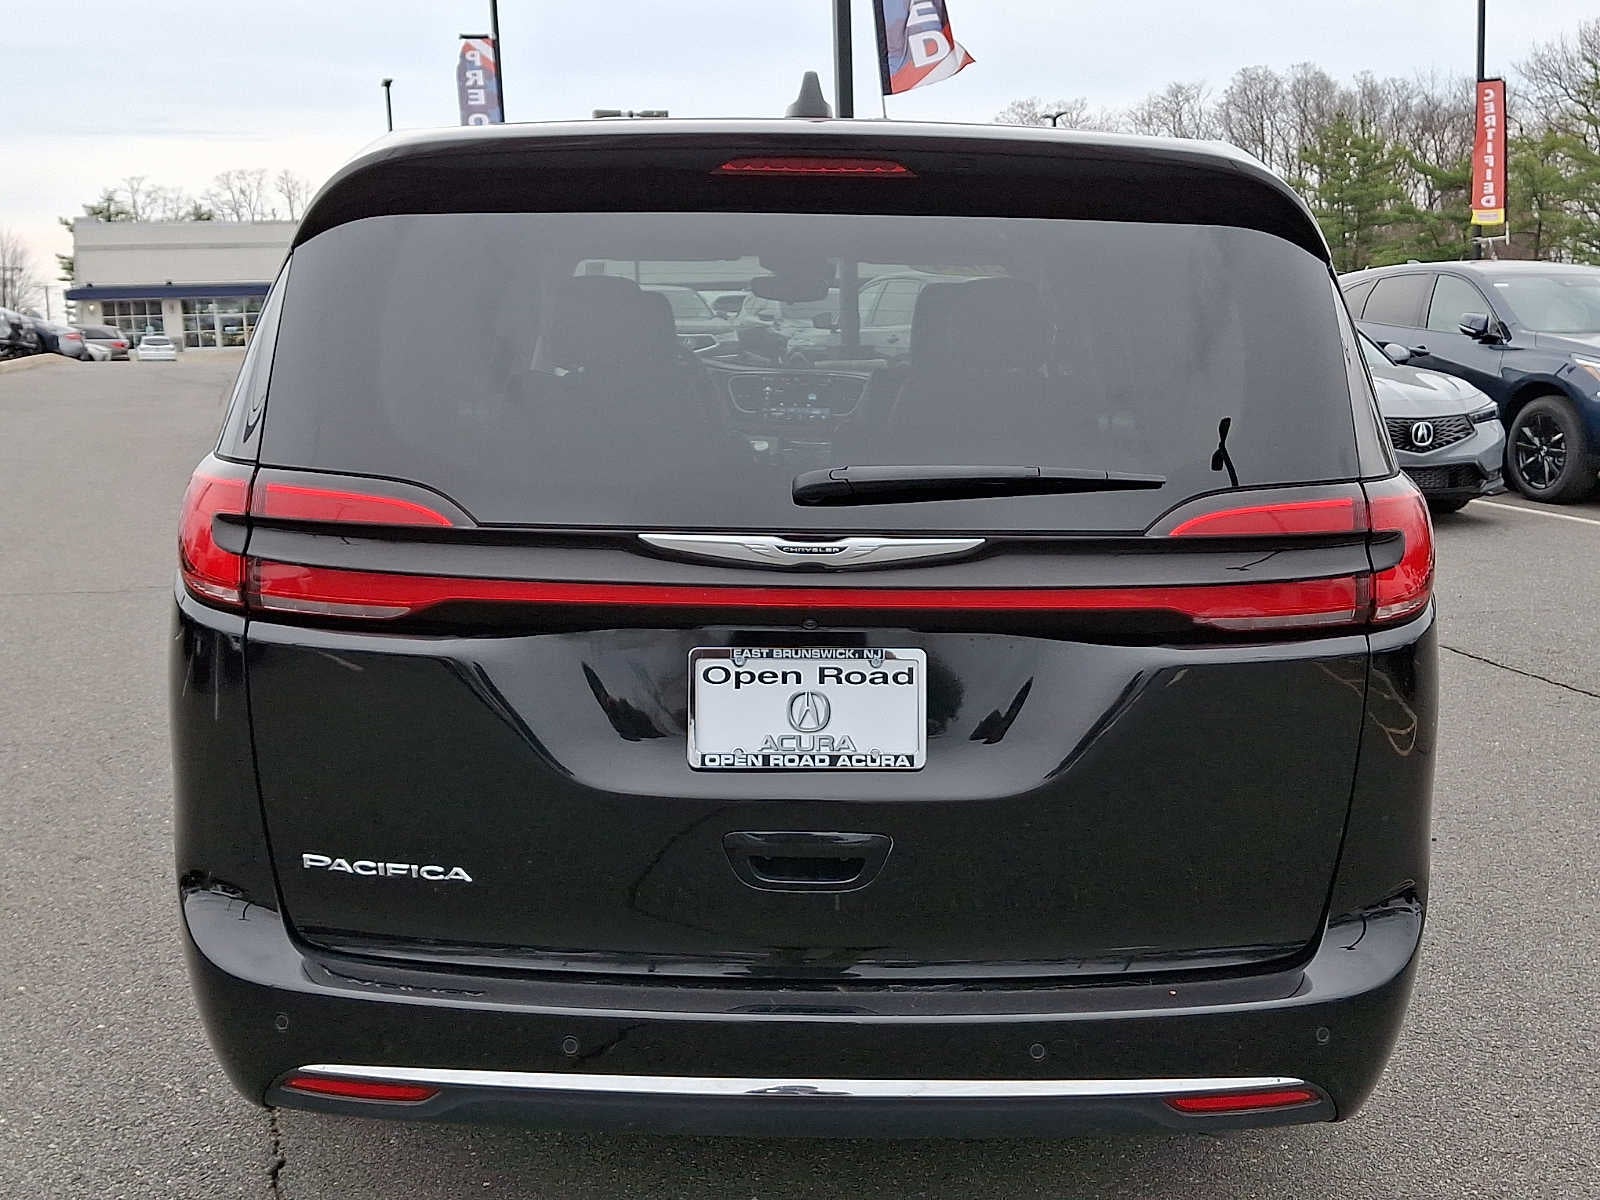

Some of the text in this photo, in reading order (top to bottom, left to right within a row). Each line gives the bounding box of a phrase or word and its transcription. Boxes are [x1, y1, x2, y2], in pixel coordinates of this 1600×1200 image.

[733, 649, 769, 658] EAST
[863, 649, 882, 659] NJ
[702, 665, 915, 690] Open Road
[758, 734, 857, 752] ACURA
[704, 754, 911, 767] OPEN ROAD ACURA
[302, 853, 473, 883] PACIFICA
